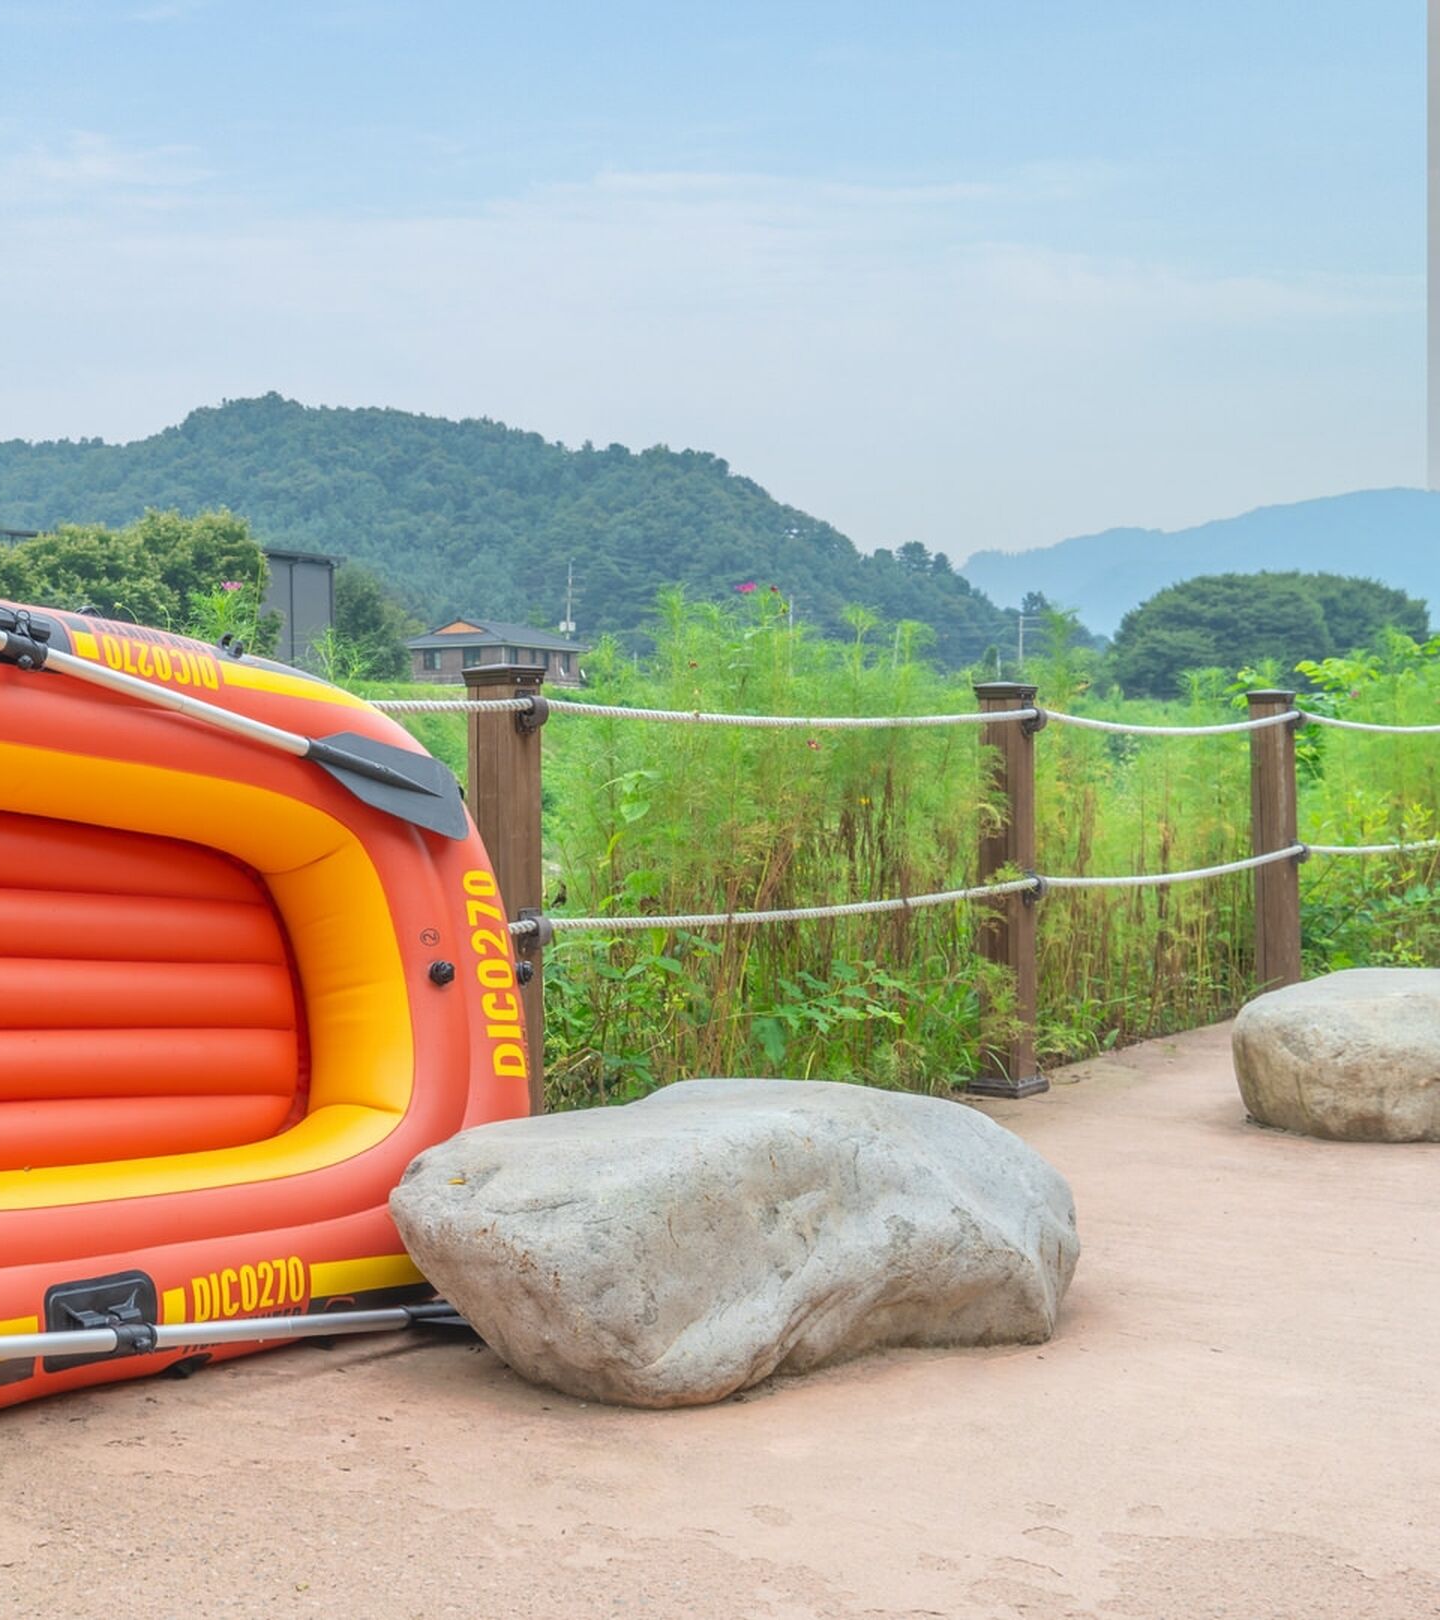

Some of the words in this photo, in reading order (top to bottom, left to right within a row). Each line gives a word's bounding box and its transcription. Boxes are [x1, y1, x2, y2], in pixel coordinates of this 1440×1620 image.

[102, 634, 219, 690] DICO270
[463, 870, 527, 1078] DICO270
[192, 1256, 304, 1322] DICO270
